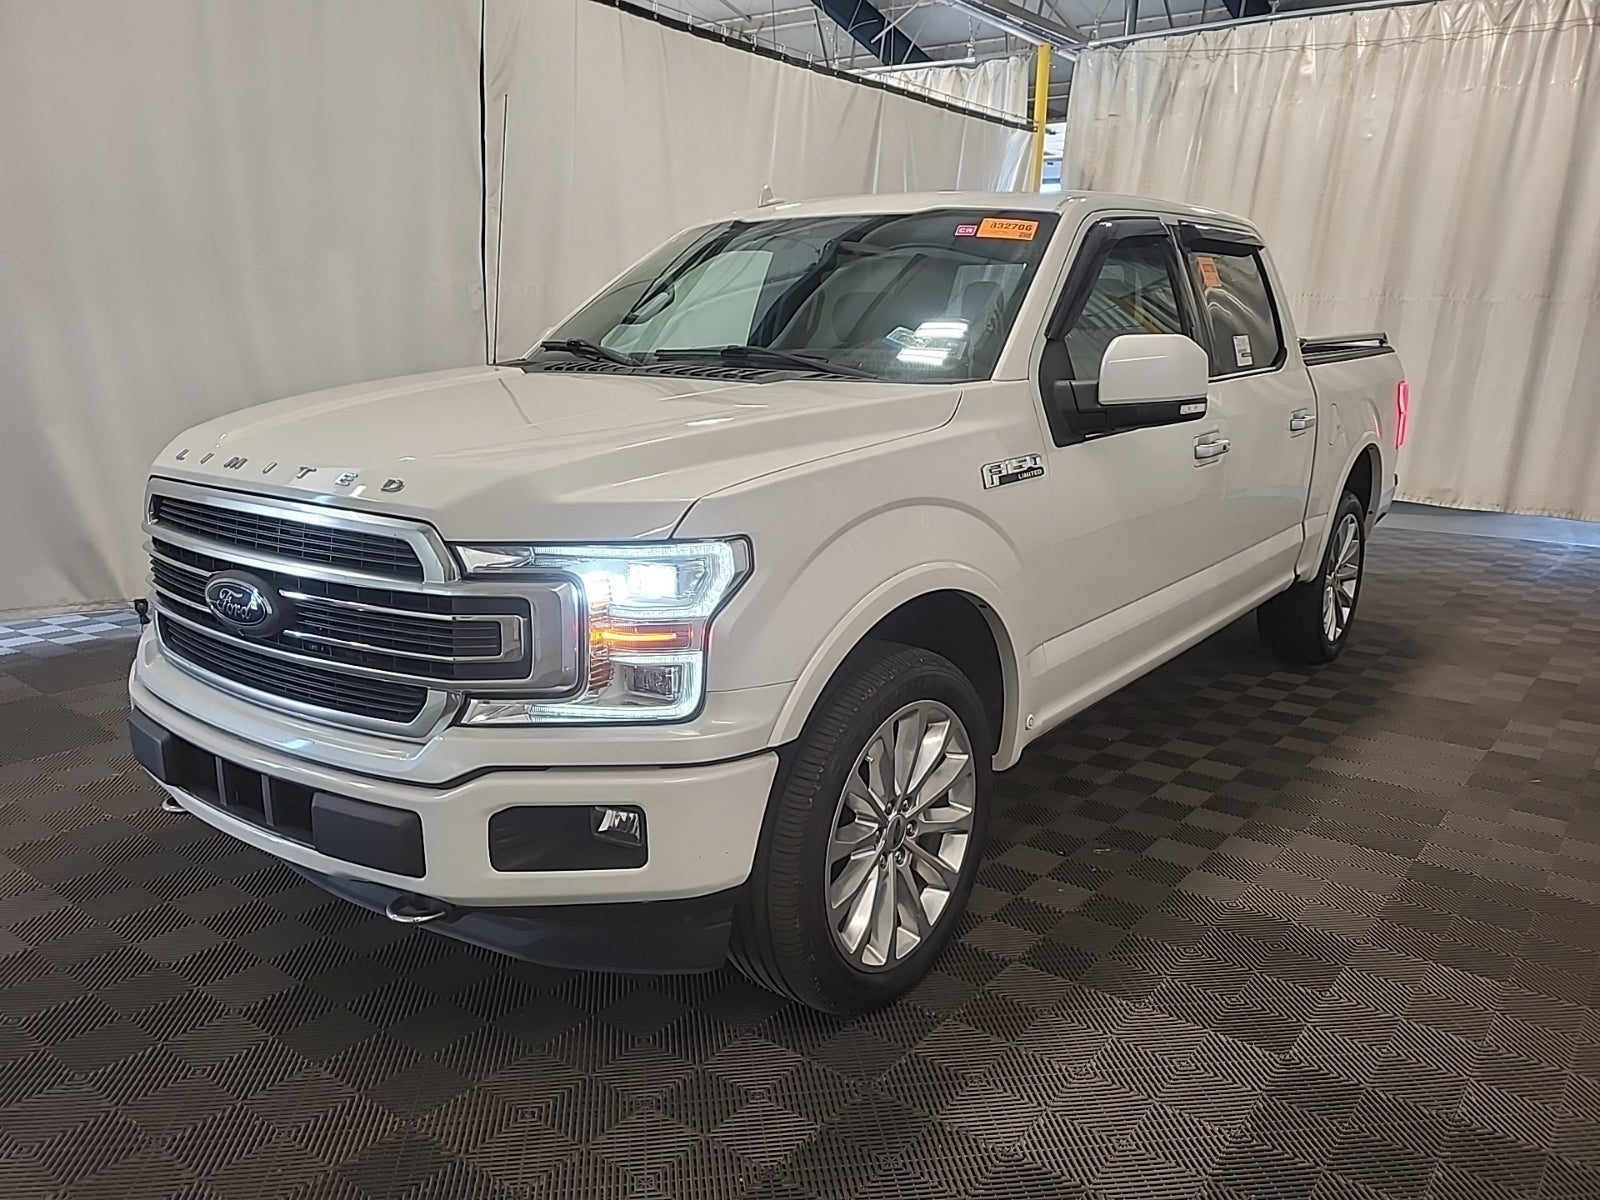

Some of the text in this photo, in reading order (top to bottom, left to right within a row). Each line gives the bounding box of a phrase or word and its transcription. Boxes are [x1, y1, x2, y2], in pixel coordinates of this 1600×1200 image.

[176, 449, 405, 492] LIMITED
[1018, 468, 1042, 480] LIMITED
[216, 588, 252, 620] Ford
